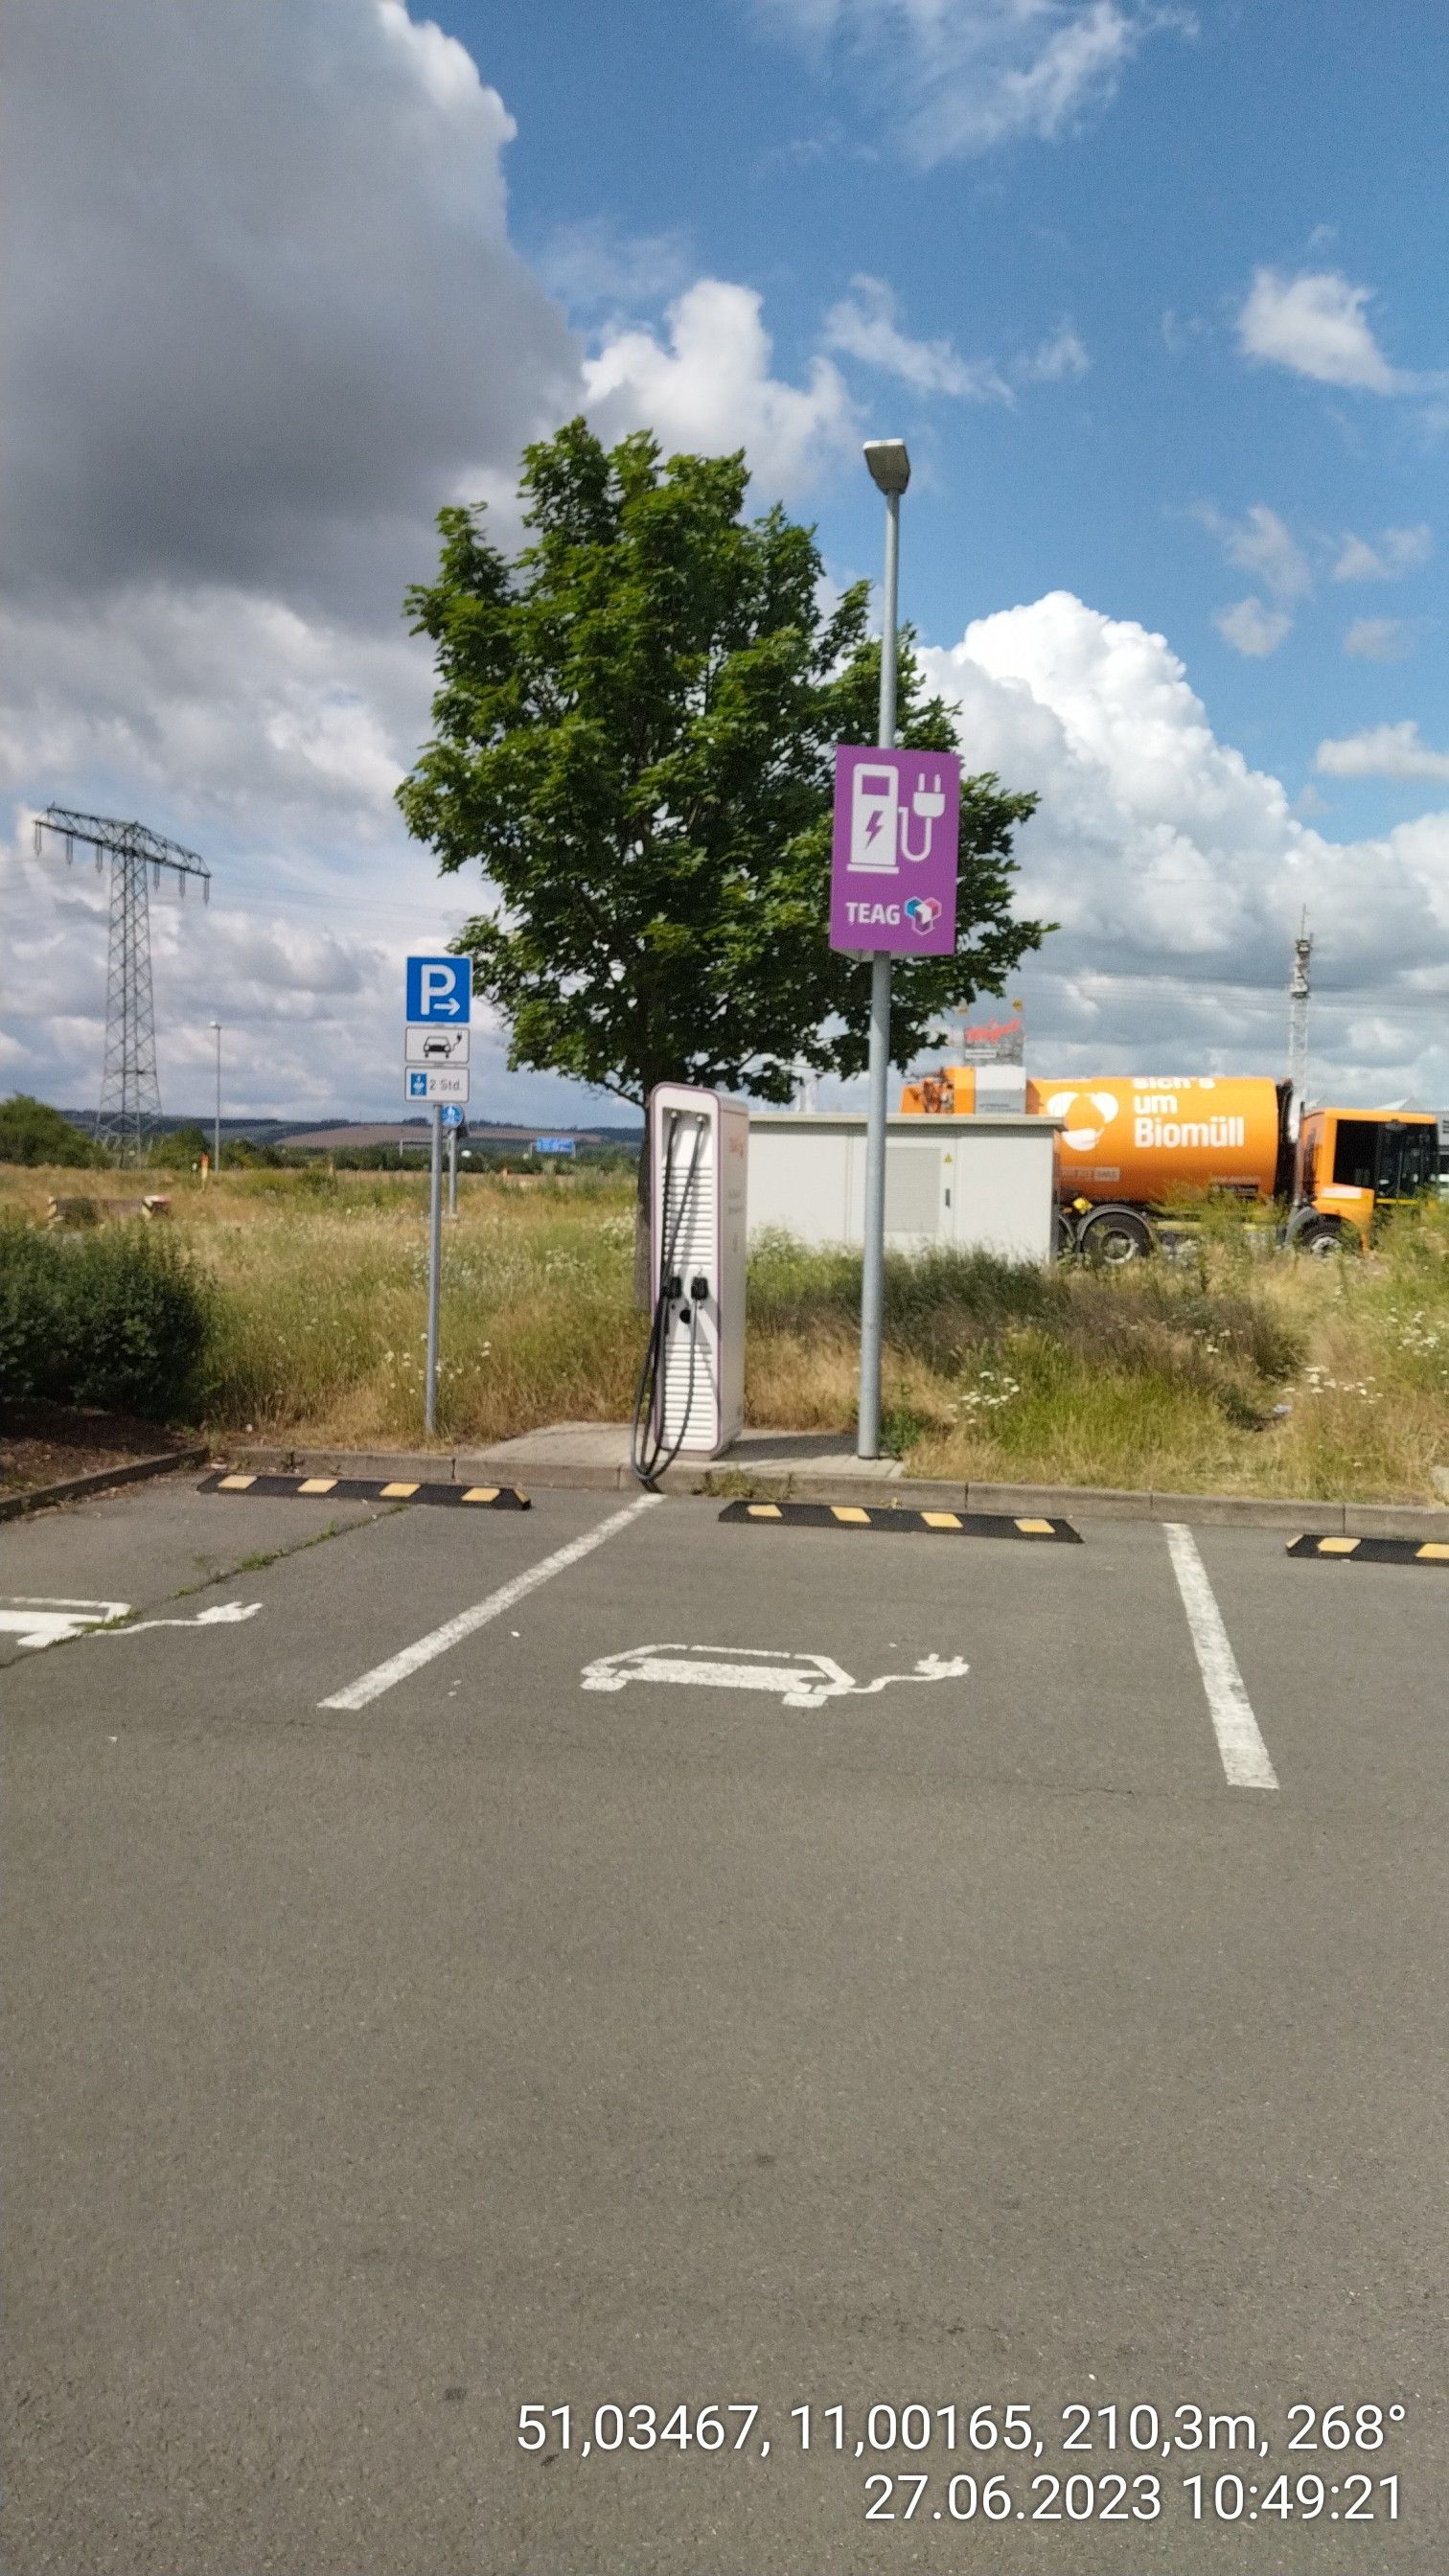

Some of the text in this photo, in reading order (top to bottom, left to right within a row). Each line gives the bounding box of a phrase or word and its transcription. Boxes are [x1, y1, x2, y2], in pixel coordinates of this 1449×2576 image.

[845, 902, 901, 926] TEAG
[421, 964, 456, 1016] P
[429, 1078, 437, 1091] 2
[1134, 1094, 1178, 1114] um
[1135, 1116, 1245, 1148] Biomüll
